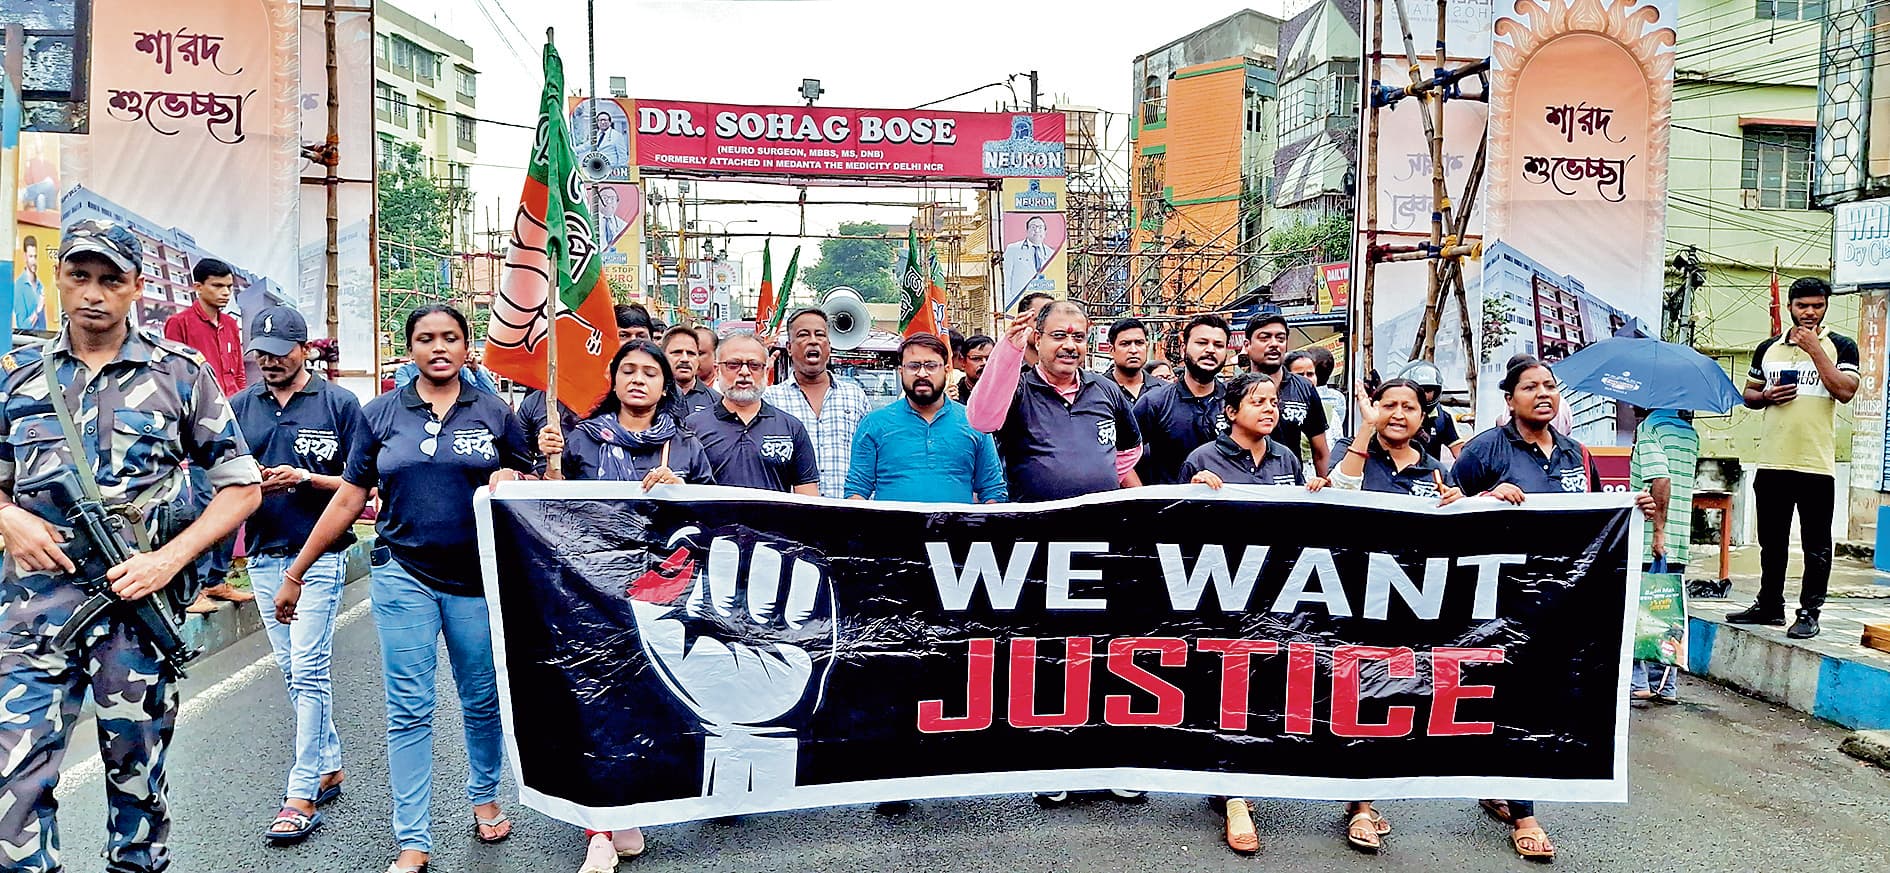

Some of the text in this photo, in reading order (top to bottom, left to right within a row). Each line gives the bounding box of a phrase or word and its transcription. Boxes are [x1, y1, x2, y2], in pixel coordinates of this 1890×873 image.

[134, 27, 243, 75] শারদ
[107, 89, 257, 144] শুভেচ্ছা
[638, 107, 957, 144] DR. SOHAG BOSE
[1545, 101, 1626, 143] শারদ
[655, 154, 944, 171] FORMERLY ATTACHED IN MEDANTA THE MEDICITY DELHI NCR
[717, 145, 884, 159] (NEURO SURGEON, MBBS, MS, DNB)
[984, 151, 1062, 169] NEURON
[1523, 154, 1636, 202] শুভেচ্ছা
[1015, 197, 1056, 208] NEURON
[1843, 242, 1868, 267] Dry
[924, 541, 1527, 621] WE WANT
[917, 637, 1505, 738] JUSTICE
